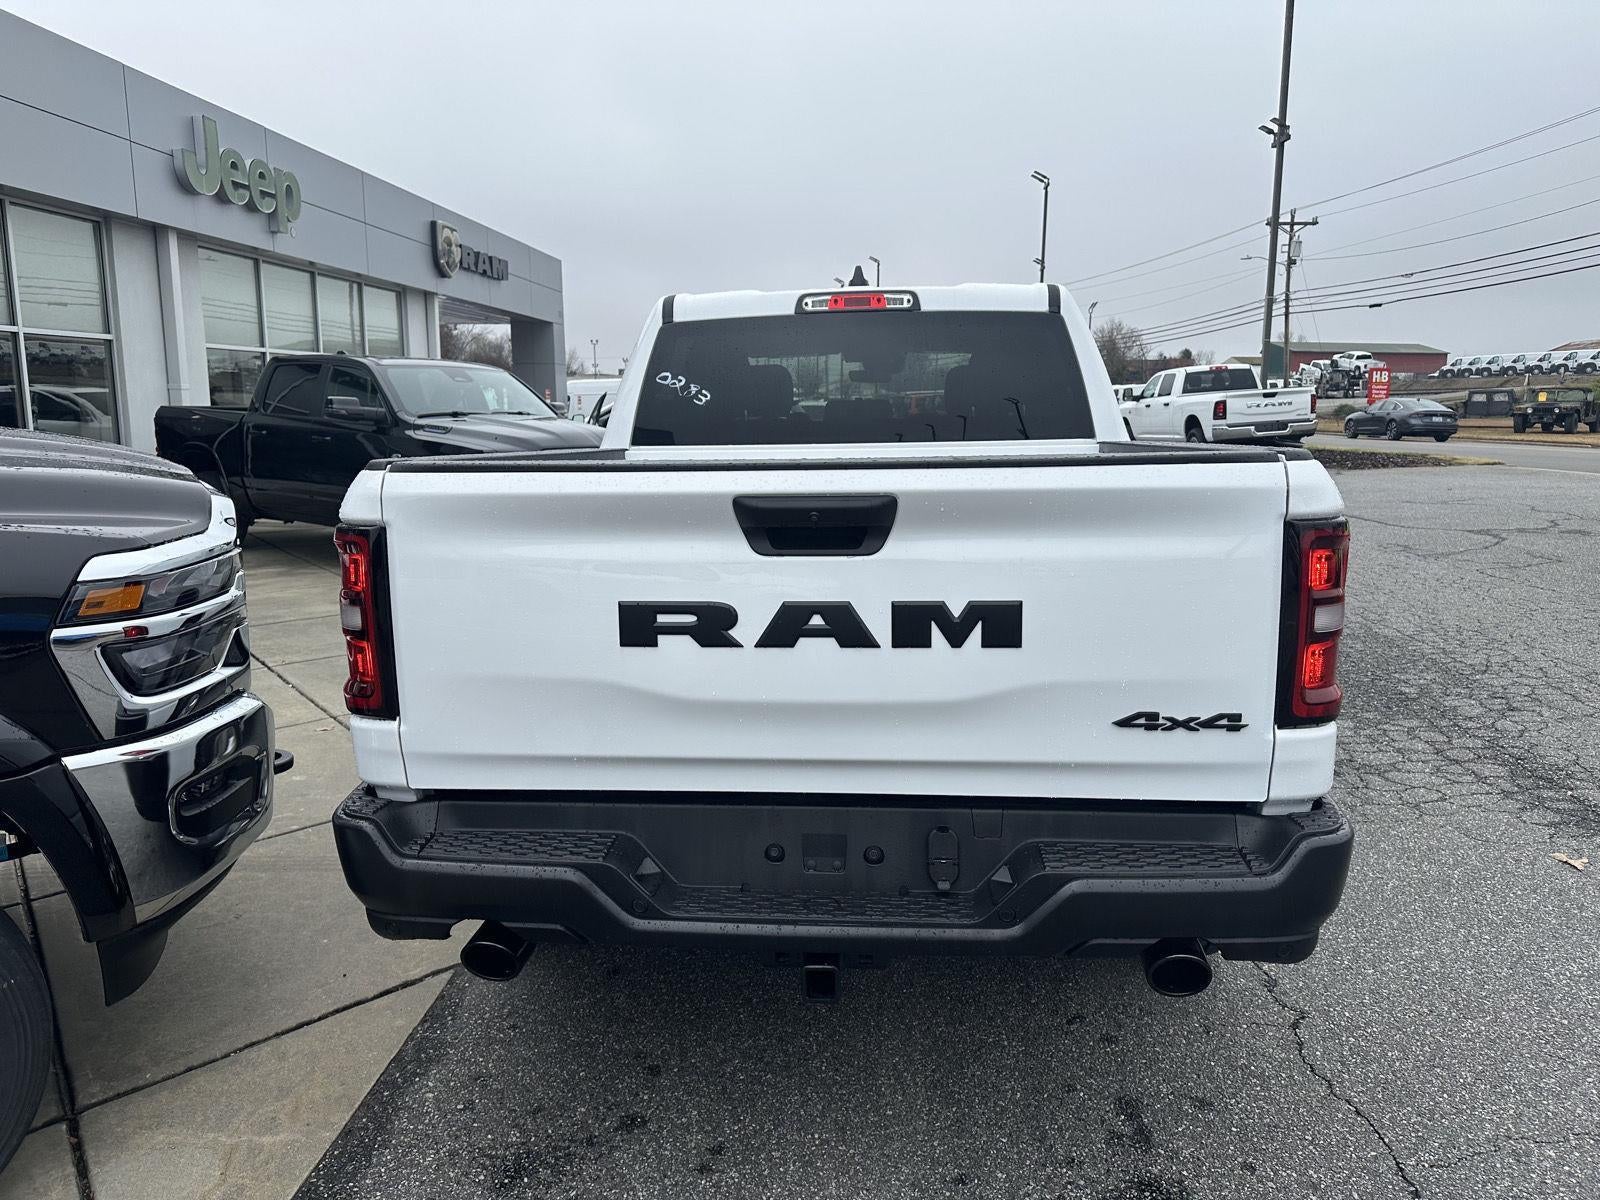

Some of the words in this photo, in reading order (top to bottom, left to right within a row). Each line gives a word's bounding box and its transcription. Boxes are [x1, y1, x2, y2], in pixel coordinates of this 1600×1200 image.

[172, 114, 301, 234] Jeep
[459, 244, 508, 281] RAM
[1246, 401, 1293, 409] RAM
[618, 600, 1023, 649] RAM
